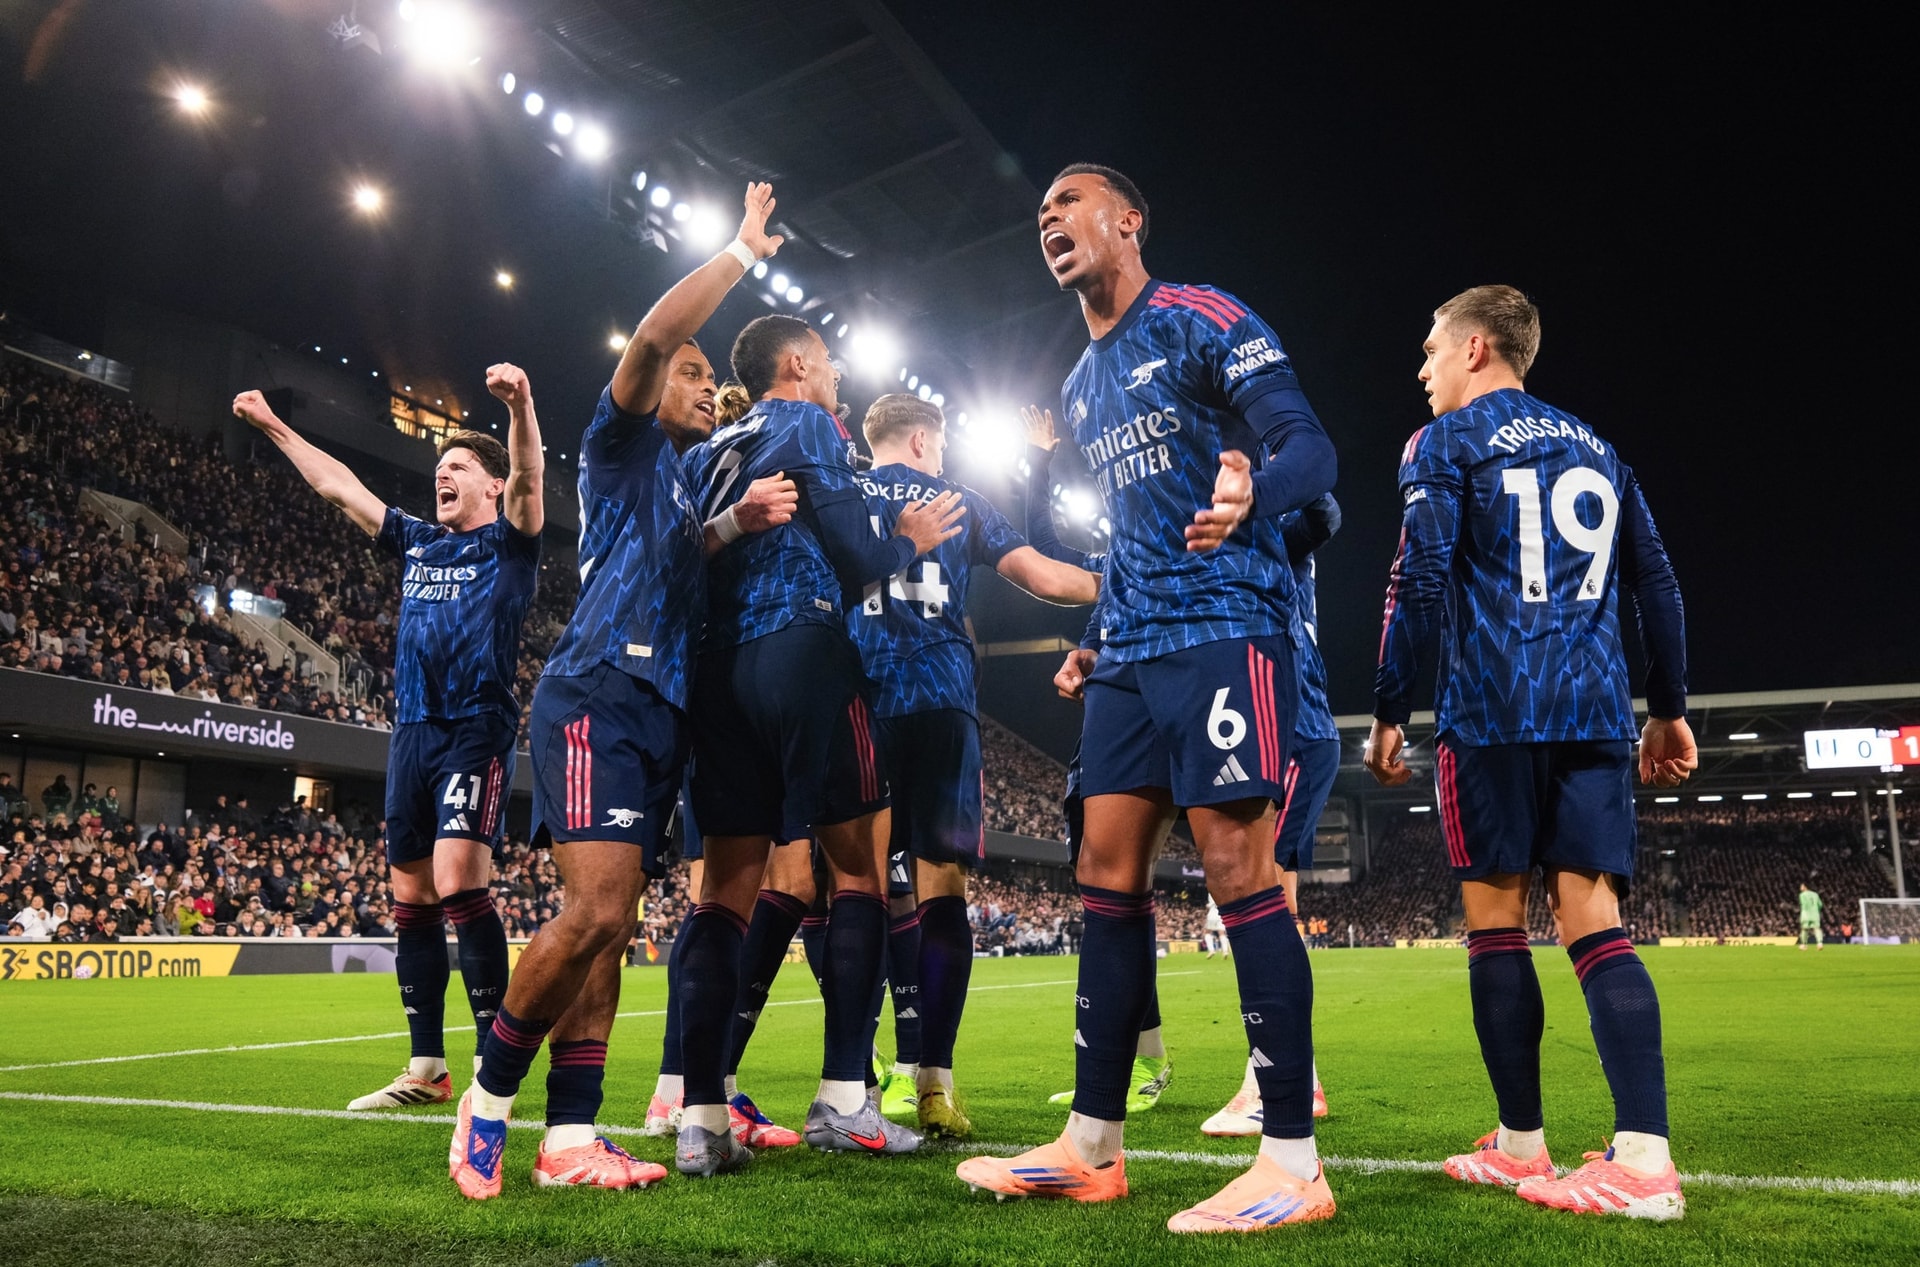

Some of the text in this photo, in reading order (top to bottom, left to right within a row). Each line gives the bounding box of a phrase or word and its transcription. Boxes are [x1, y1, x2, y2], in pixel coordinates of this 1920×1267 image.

[1232, 337, 1269, 359] VISIT
[1225, 349, 1288, 380] RWANDA
[1488, 416, 1606, 456] TROSSARD
[1114, 443, 1172, 489] BETTER
[859, 476, 938, 505] ÖKERE
[1502, 467, 1619, 602] 19
[416, 583, 460, 600] BETTER
[94, 693, 295, 750] the riverside
[1207, 687, 1247, 750] 6
[1858, 735, 1919, 759] 0 1
[443, 773, 482, 811] 41
[36, 948, 201, 979] SBOTOP.com
[399, 985, 414, 993] FC
[471, 986, 497, 997] AFC
[895, 985, 918, 994] AFC
[1075, 994, 1090, 1009] FC
[1242, 1012, 1263, 1024] FC
